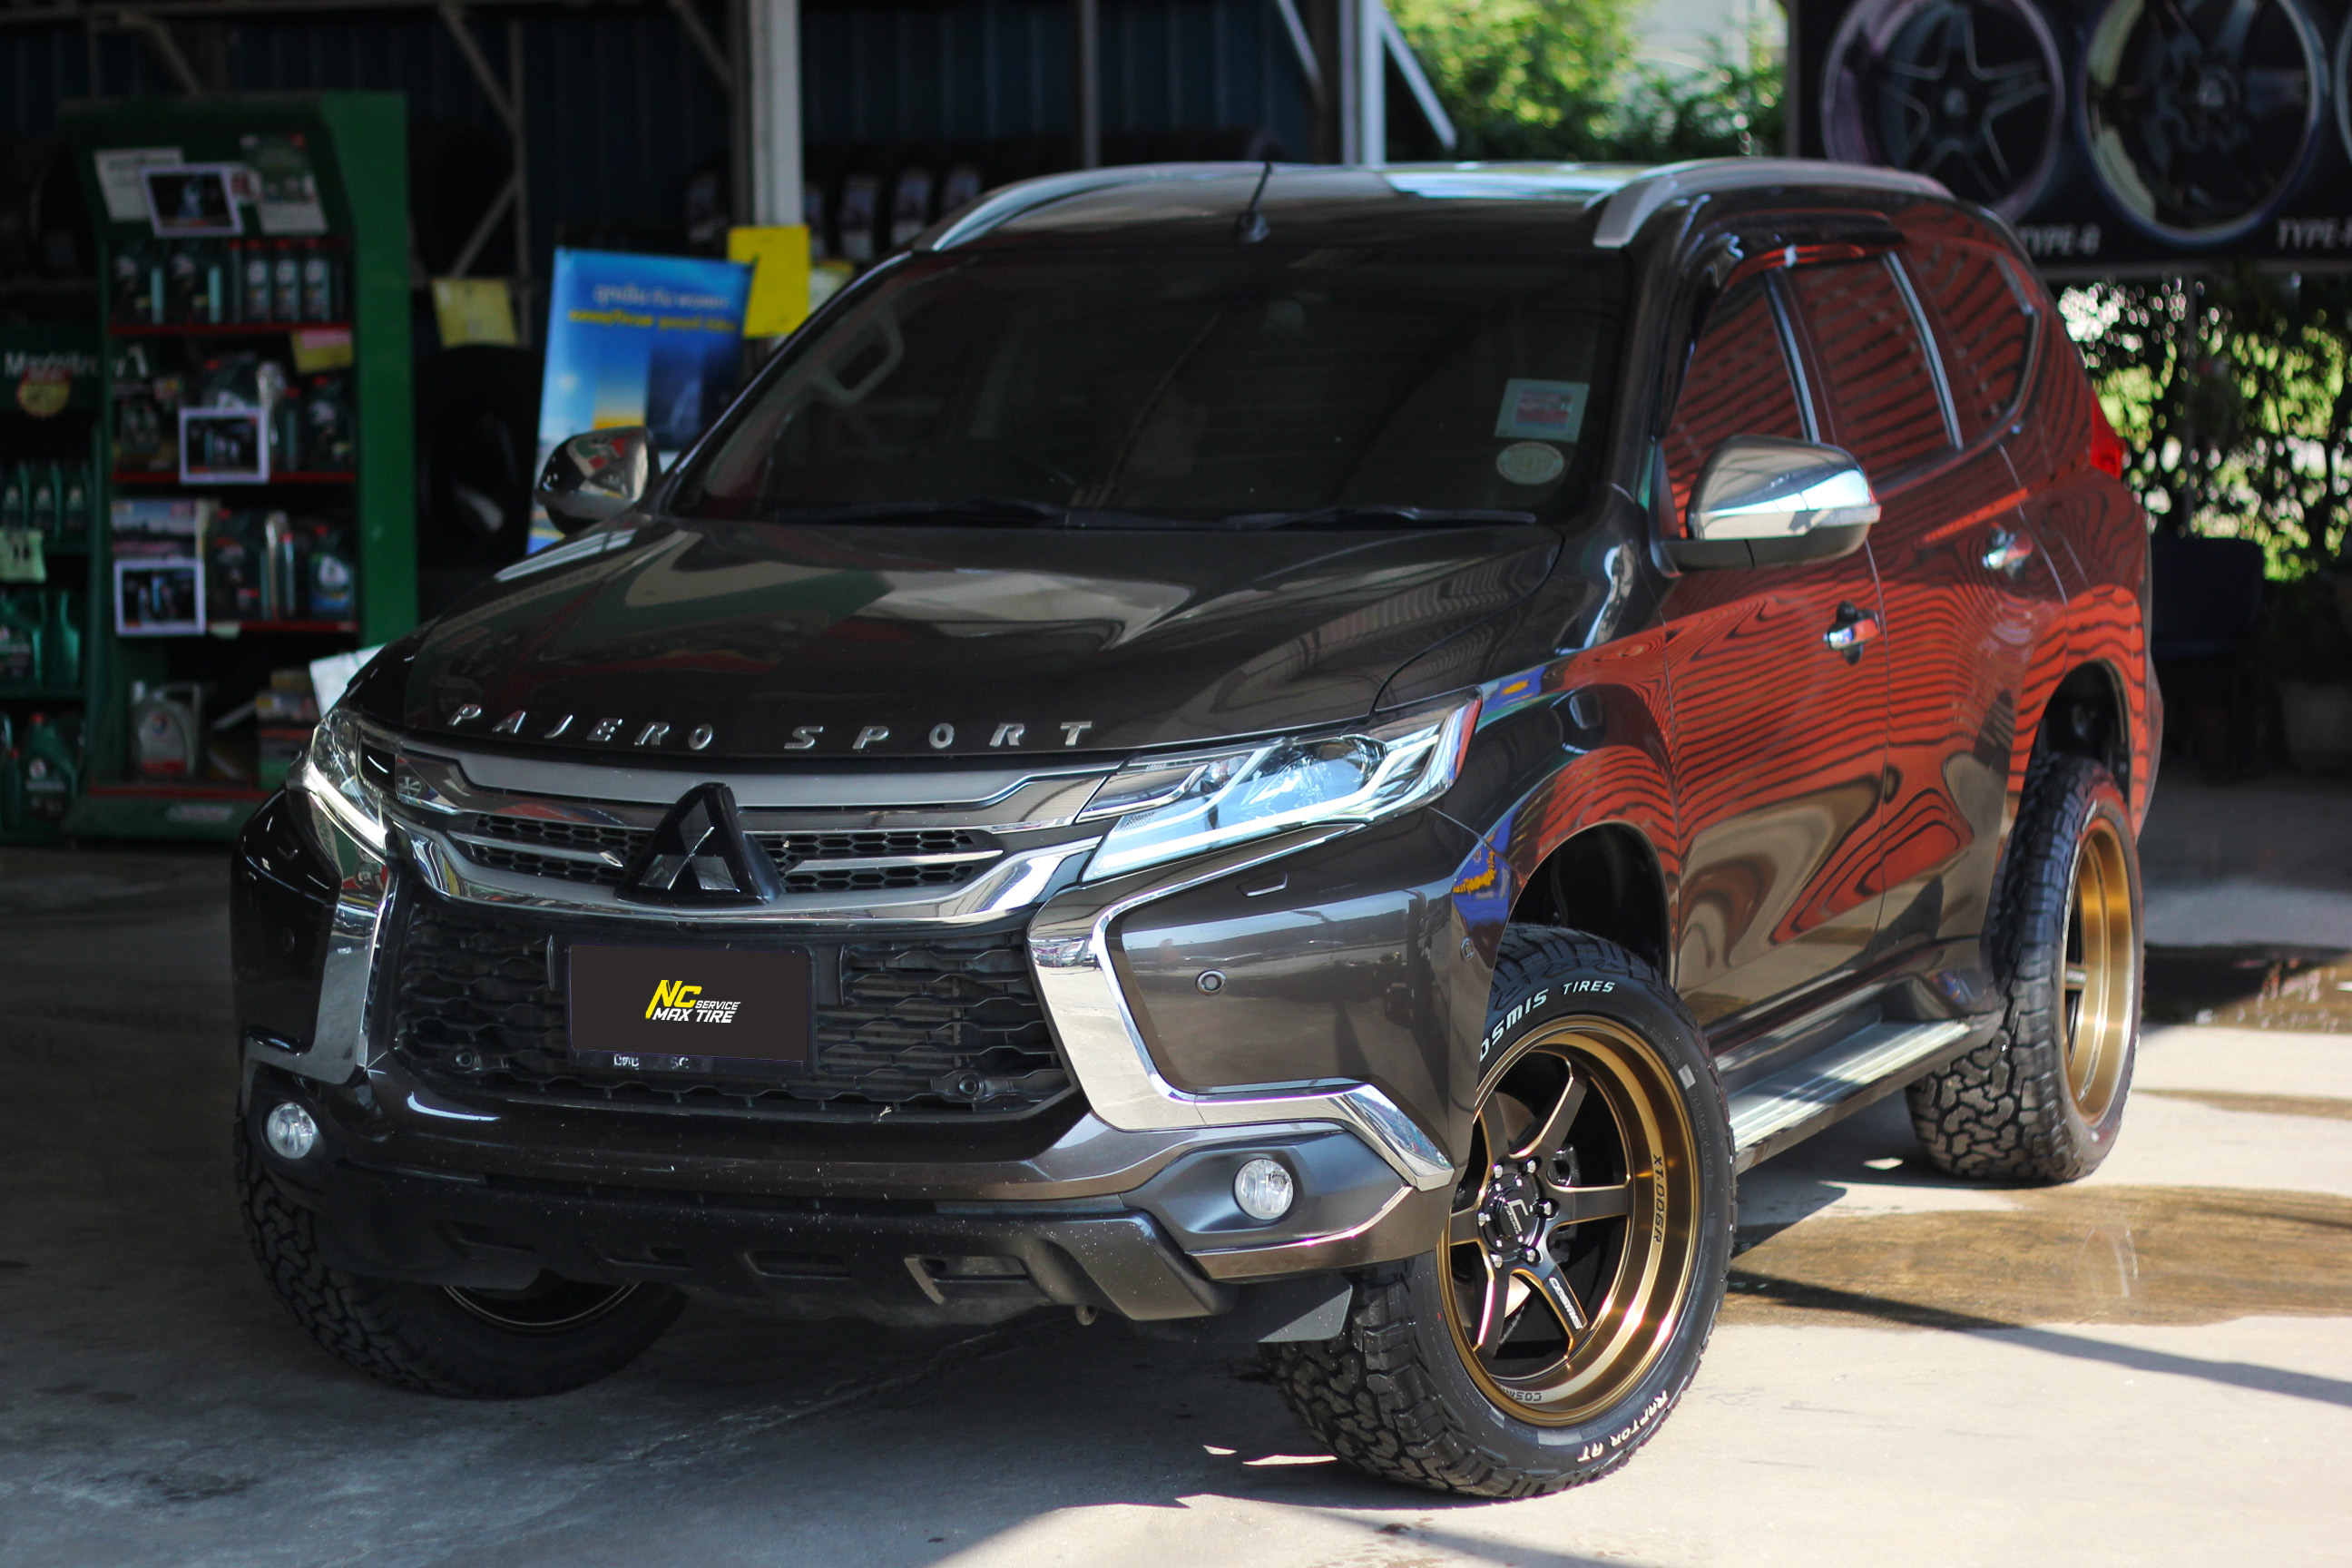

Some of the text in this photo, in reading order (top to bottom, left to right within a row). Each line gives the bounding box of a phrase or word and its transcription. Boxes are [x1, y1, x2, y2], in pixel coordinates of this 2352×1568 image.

[447, 703, 1093, 750] PAJERO SPORT
[1479, 980, 1616, 1063] OSMIS TIRES
[1609, 1389, 1669, 1447] RAPTOR
[1577, 1442, 1604, 1463] AT
